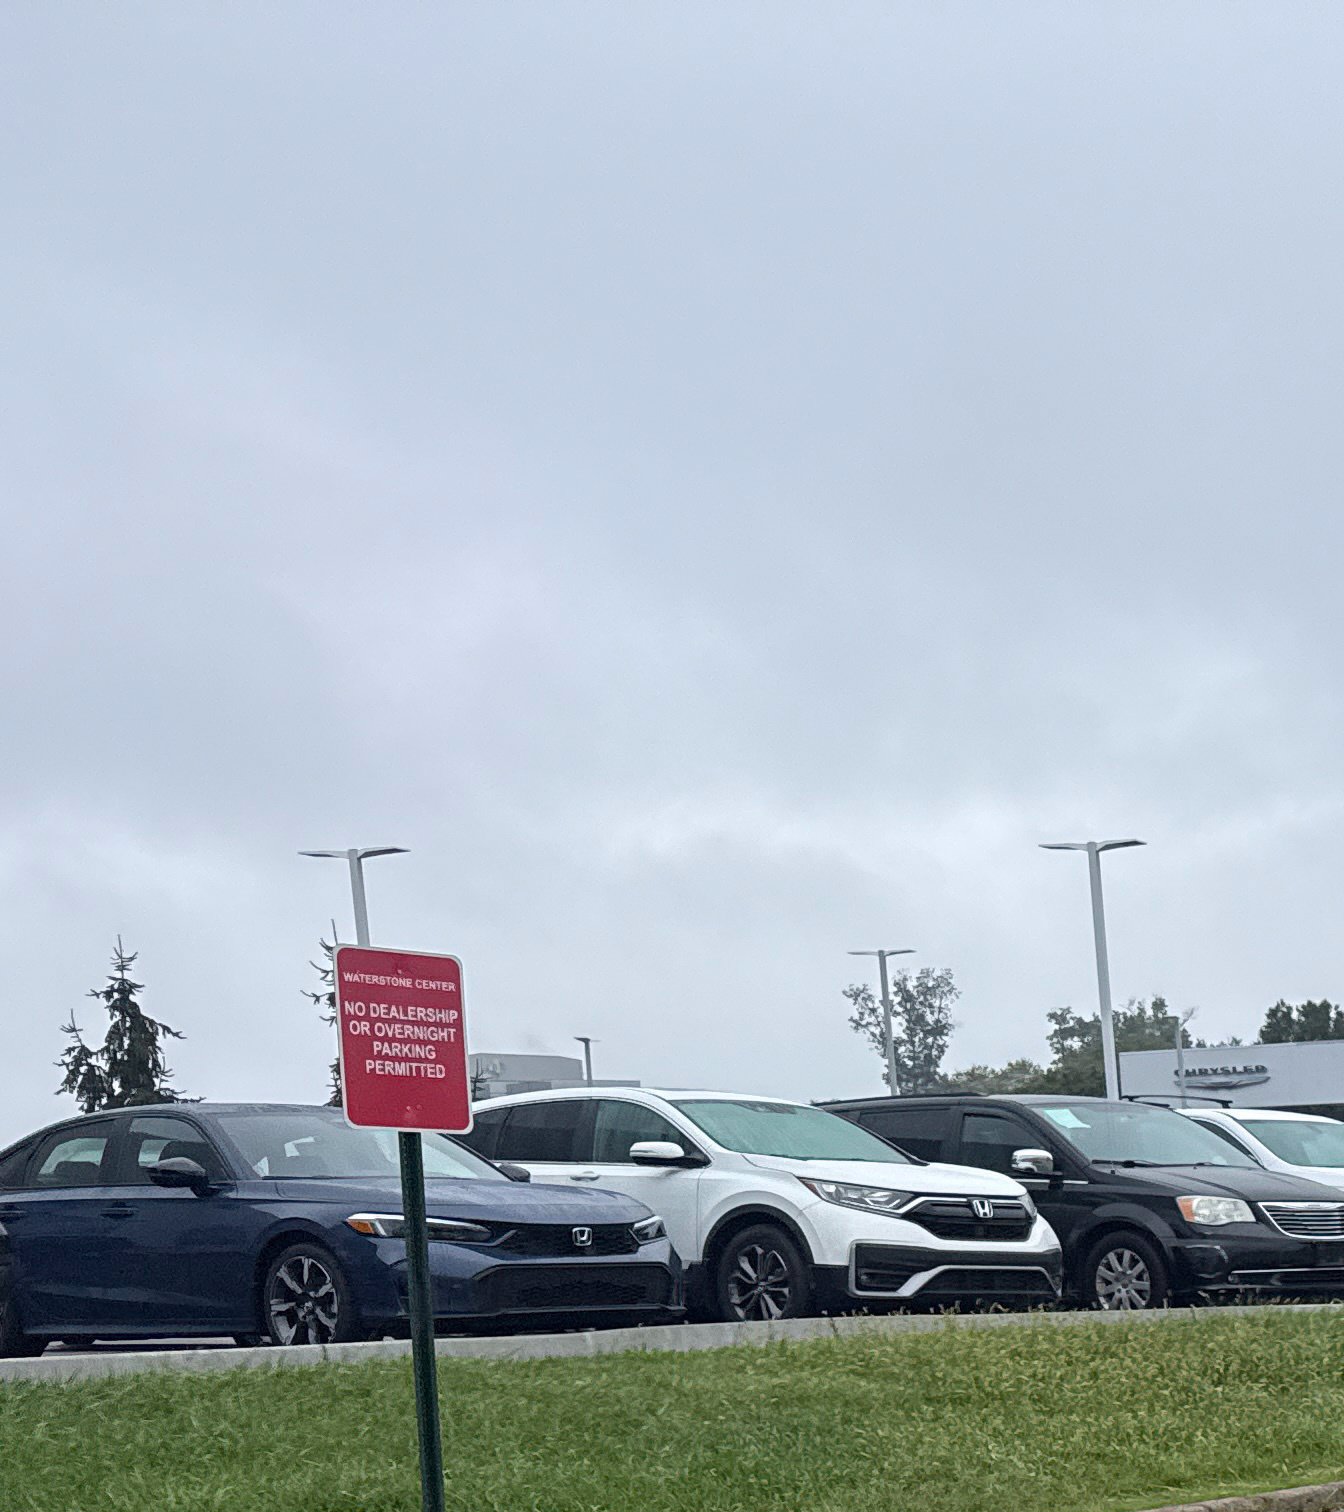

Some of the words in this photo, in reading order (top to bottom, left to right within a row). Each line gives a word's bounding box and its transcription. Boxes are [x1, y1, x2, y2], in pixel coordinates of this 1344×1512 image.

[343, 971, 413, 988] WATERSTONE
[415, 979, 456, 992] CENTER
[344, 1000, 366, 1017] NO
[369, 1003, 458, 1024] DEALERSHIP
[349, 1020, 371, 1036] OR
[374, 1022, 456, 1042] OVERNIGHT
[373, 1041, 436, 1059] PARKING
[365, 1060, 446, 1079] PERMITTED
